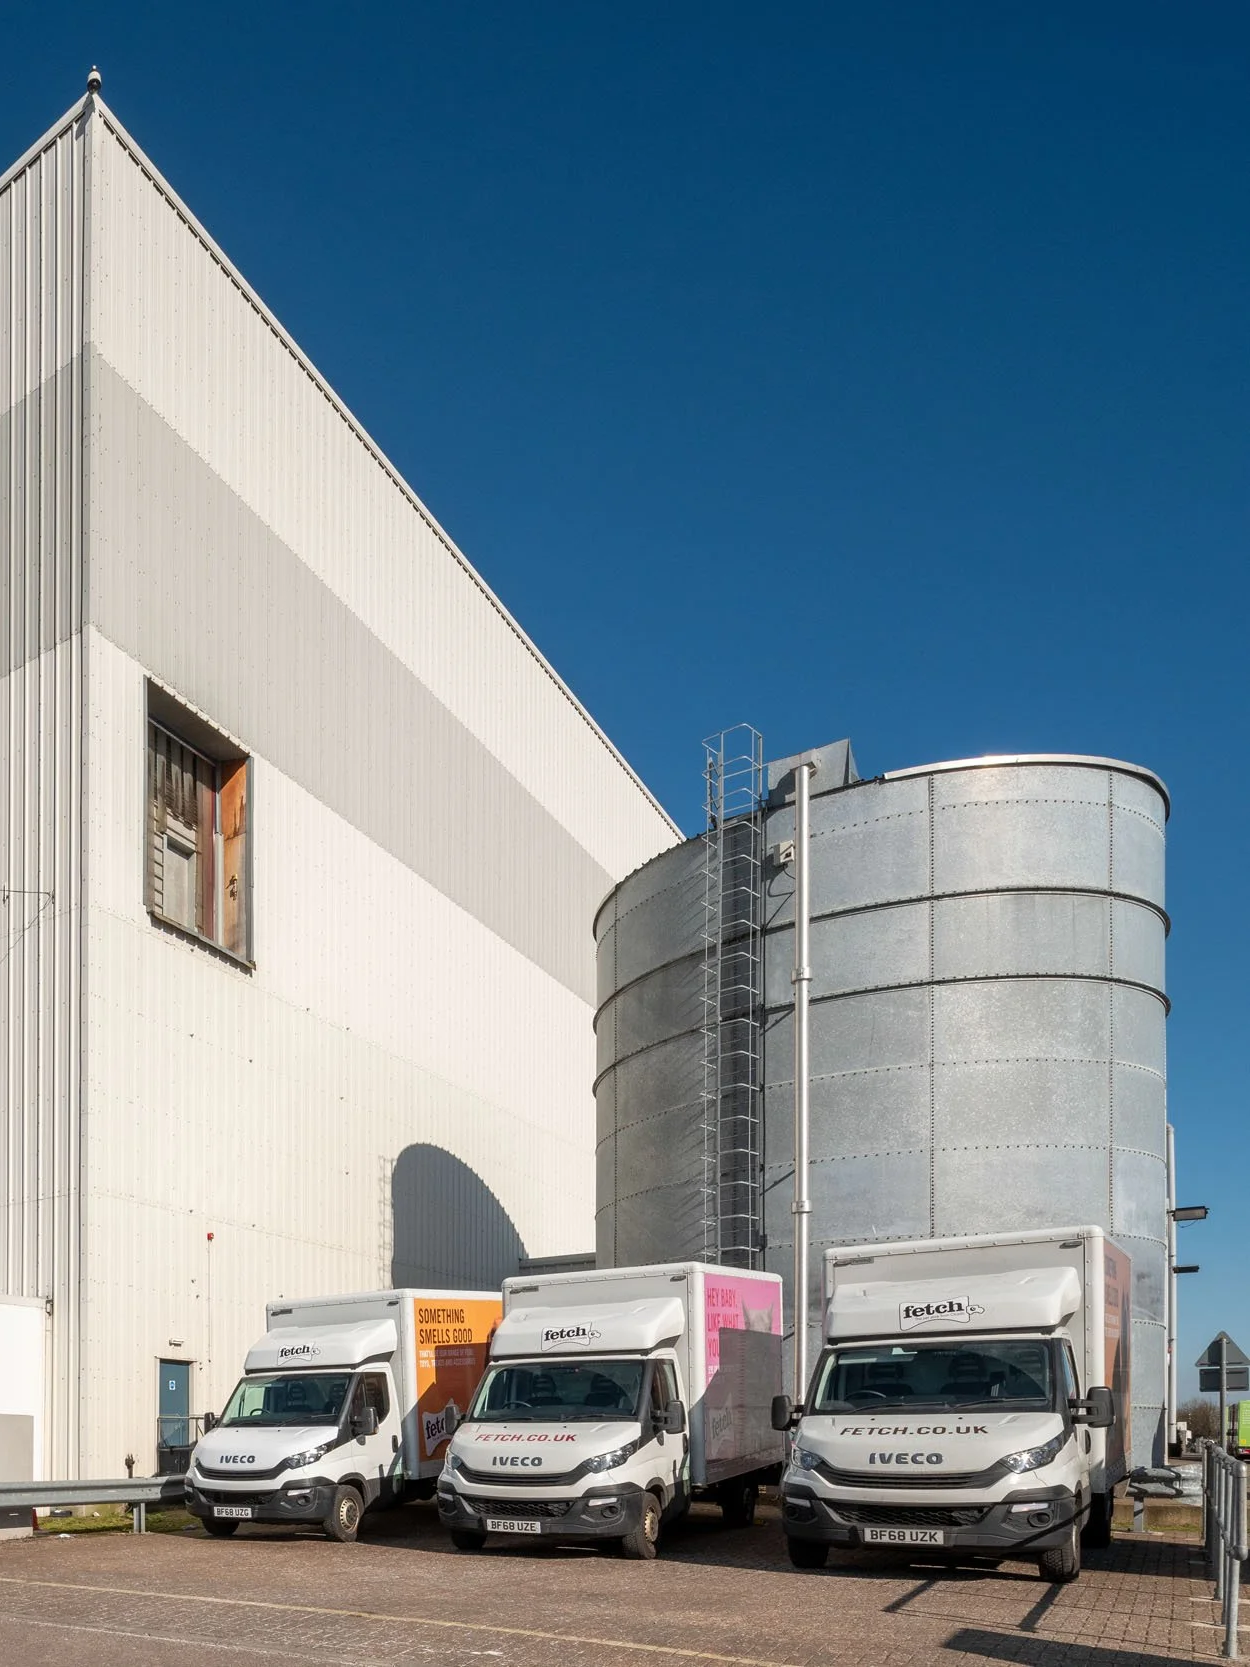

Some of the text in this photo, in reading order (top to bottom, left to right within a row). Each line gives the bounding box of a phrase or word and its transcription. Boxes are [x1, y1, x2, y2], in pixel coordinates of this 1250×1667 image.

[707, 1287, 719, 1307] HEY
[418, 1308, 465, 1324] SOMETHING
[903, 1301, 964, 1319] fetch
[707, 1313, 739, 1332] LIKE WHAT
[419, 1328, 473, 1344] SMELLS GOOD
[544, 1327, 588, 1341] fetch
[279, 1345, 311, 1357] fetch
[840, 1425, 989, 1435] FETCH.CO.UK
[475, 1433, 577, 1442] FETCH.CO.UK
[220, 1455, 255, 1463] IVECO
[492, 1456, 543, 1466] IVECO
[868, 1452, 943, 1465] IVECO
[216, 1508, 234, 1516] BF68
[491, 1520, 537, 1531] BF68 UZE
[870, 1529, 938, 1542] BF68 UZK
